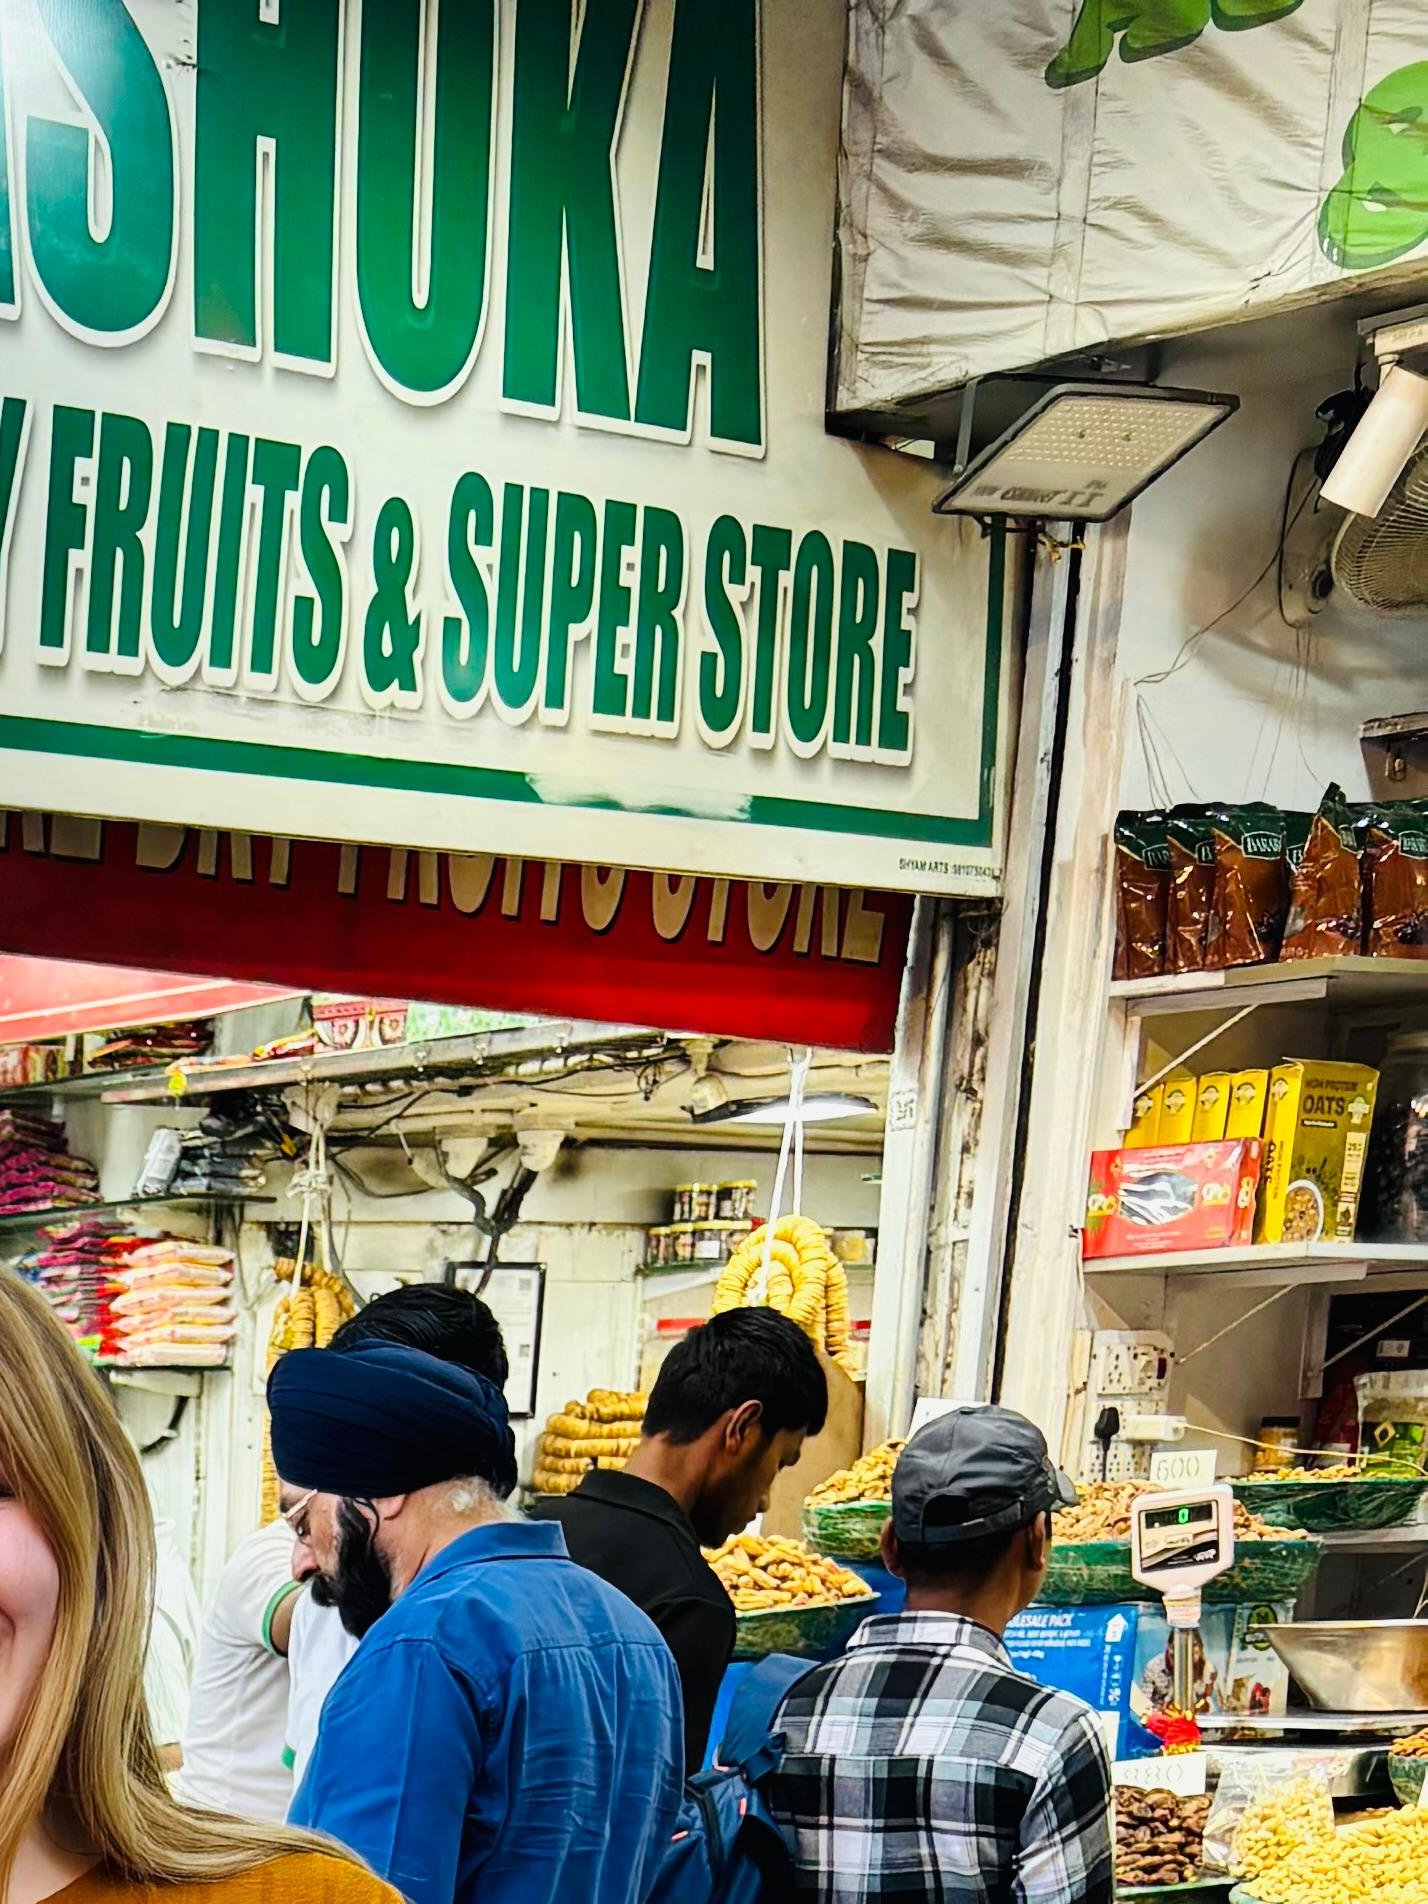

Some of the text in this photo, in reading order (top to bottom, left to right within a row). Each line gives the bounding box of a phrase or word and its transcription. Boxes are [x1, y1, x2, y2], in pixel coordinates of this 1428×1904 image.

[40, 405, 348, 700] FRUITS
[366, 496, 420, 700] &
[441, 470, 686, 740] SUPER
[700, 512, 918, 762] STORE
[1302, 1095, 1345, 1115] OATS
[1156, 1456, 1200, 1481] 600
[1178, 1507, 1190, 1525] 0
